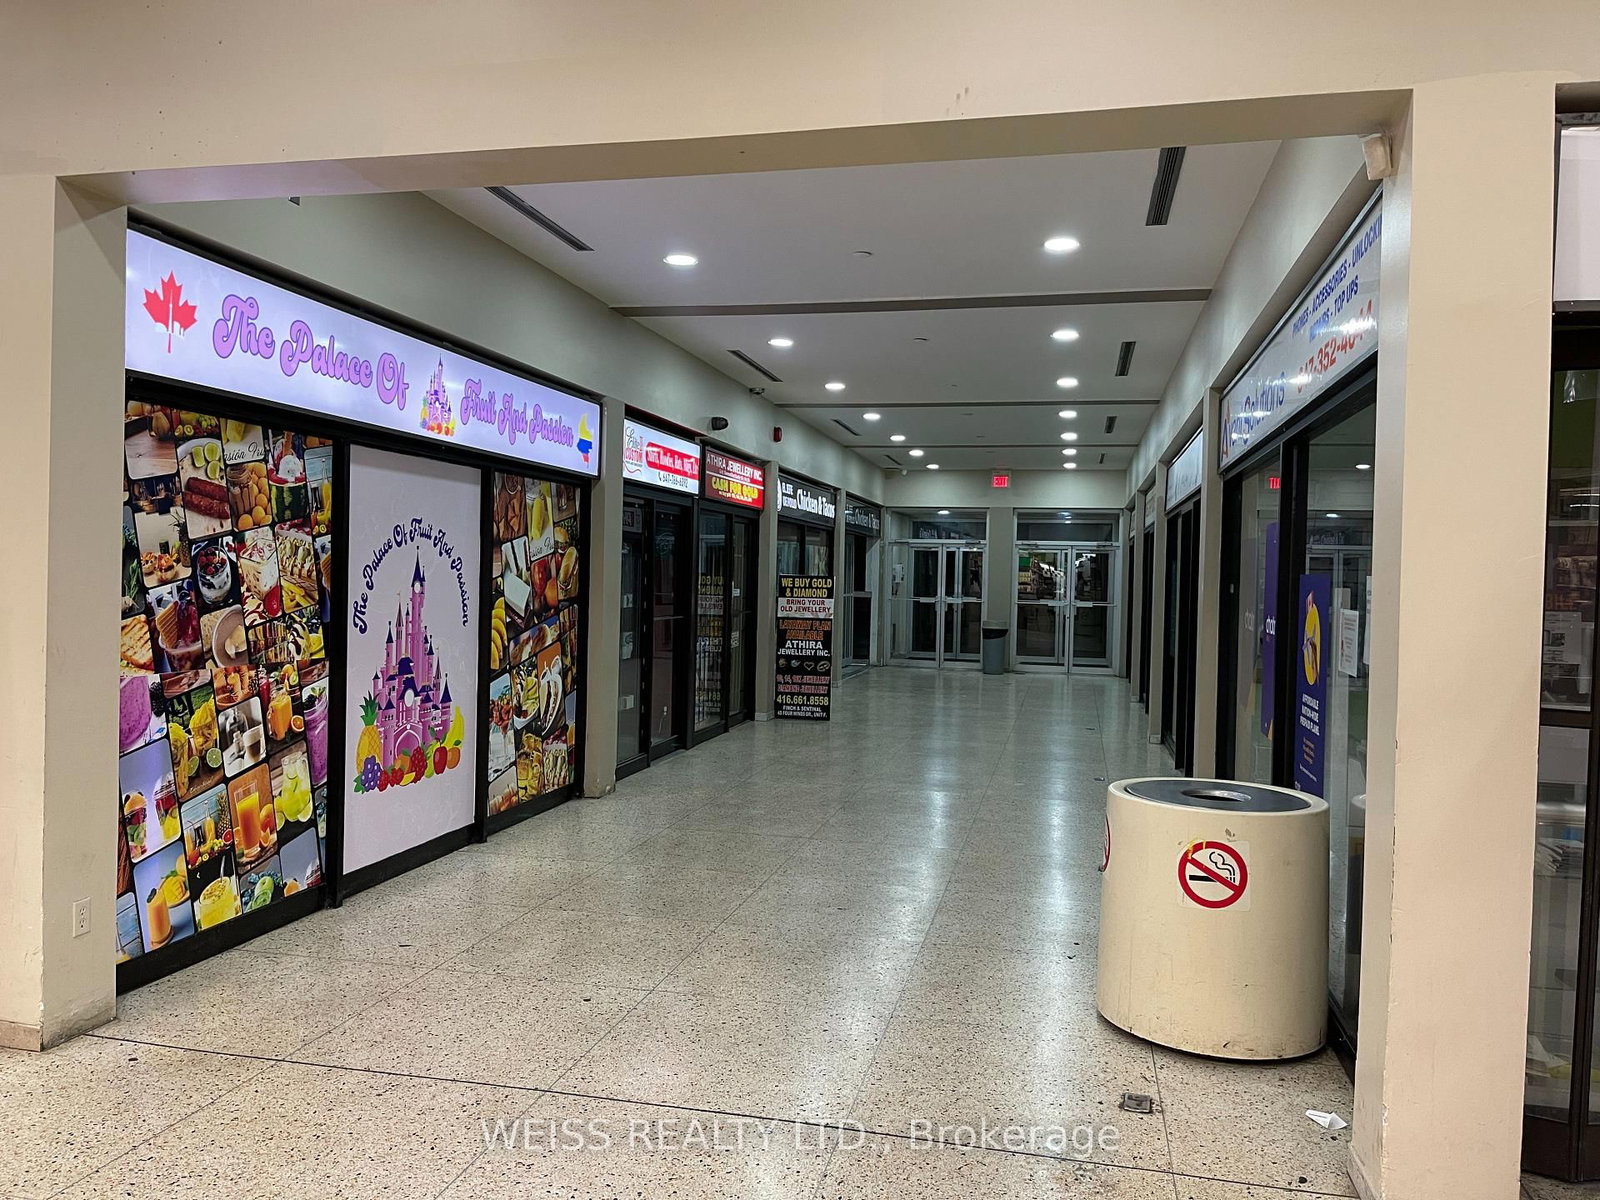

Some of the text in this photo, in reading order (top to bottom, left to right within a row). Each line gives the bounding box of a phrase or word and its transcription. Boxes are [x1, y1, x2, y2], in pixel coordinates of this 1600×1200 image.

[1311, 258, 1348, 316] ACCESSORIES
[1334, 293, 1346, 318] TOP
[1346, 273, 1359, 303] UPS
[213, 294, 410, 411] The Palace Of
[460, 379, 575, 448] Fruit And Passion
[706, 453, 727, 469] ATHIRA
[727, 461, 753, 479] JEWELLERY
[711, 476, 728, 491] CASH
[729, 481, 742, 494] FOR
[742, 484, 759, 499] GOLD
[993, 476, 1008, 488] EXIT
[796, 488, 818, 514] Chicken
[818, 495, 823, 515] &
[822, 497, 835, 519] Tacos
[352, 517, 470, 634] The Palace Of Fruit And Passion
[781, 578, 833, 589] WE BUY GOLD
[785, 588, 828, 598] & DIAMOND
[777, 648, 816, 656] JEWELLERY
[785, 640, 823, 650] ATHIRA
[776, 694, 829, 706] 416.661.8558
